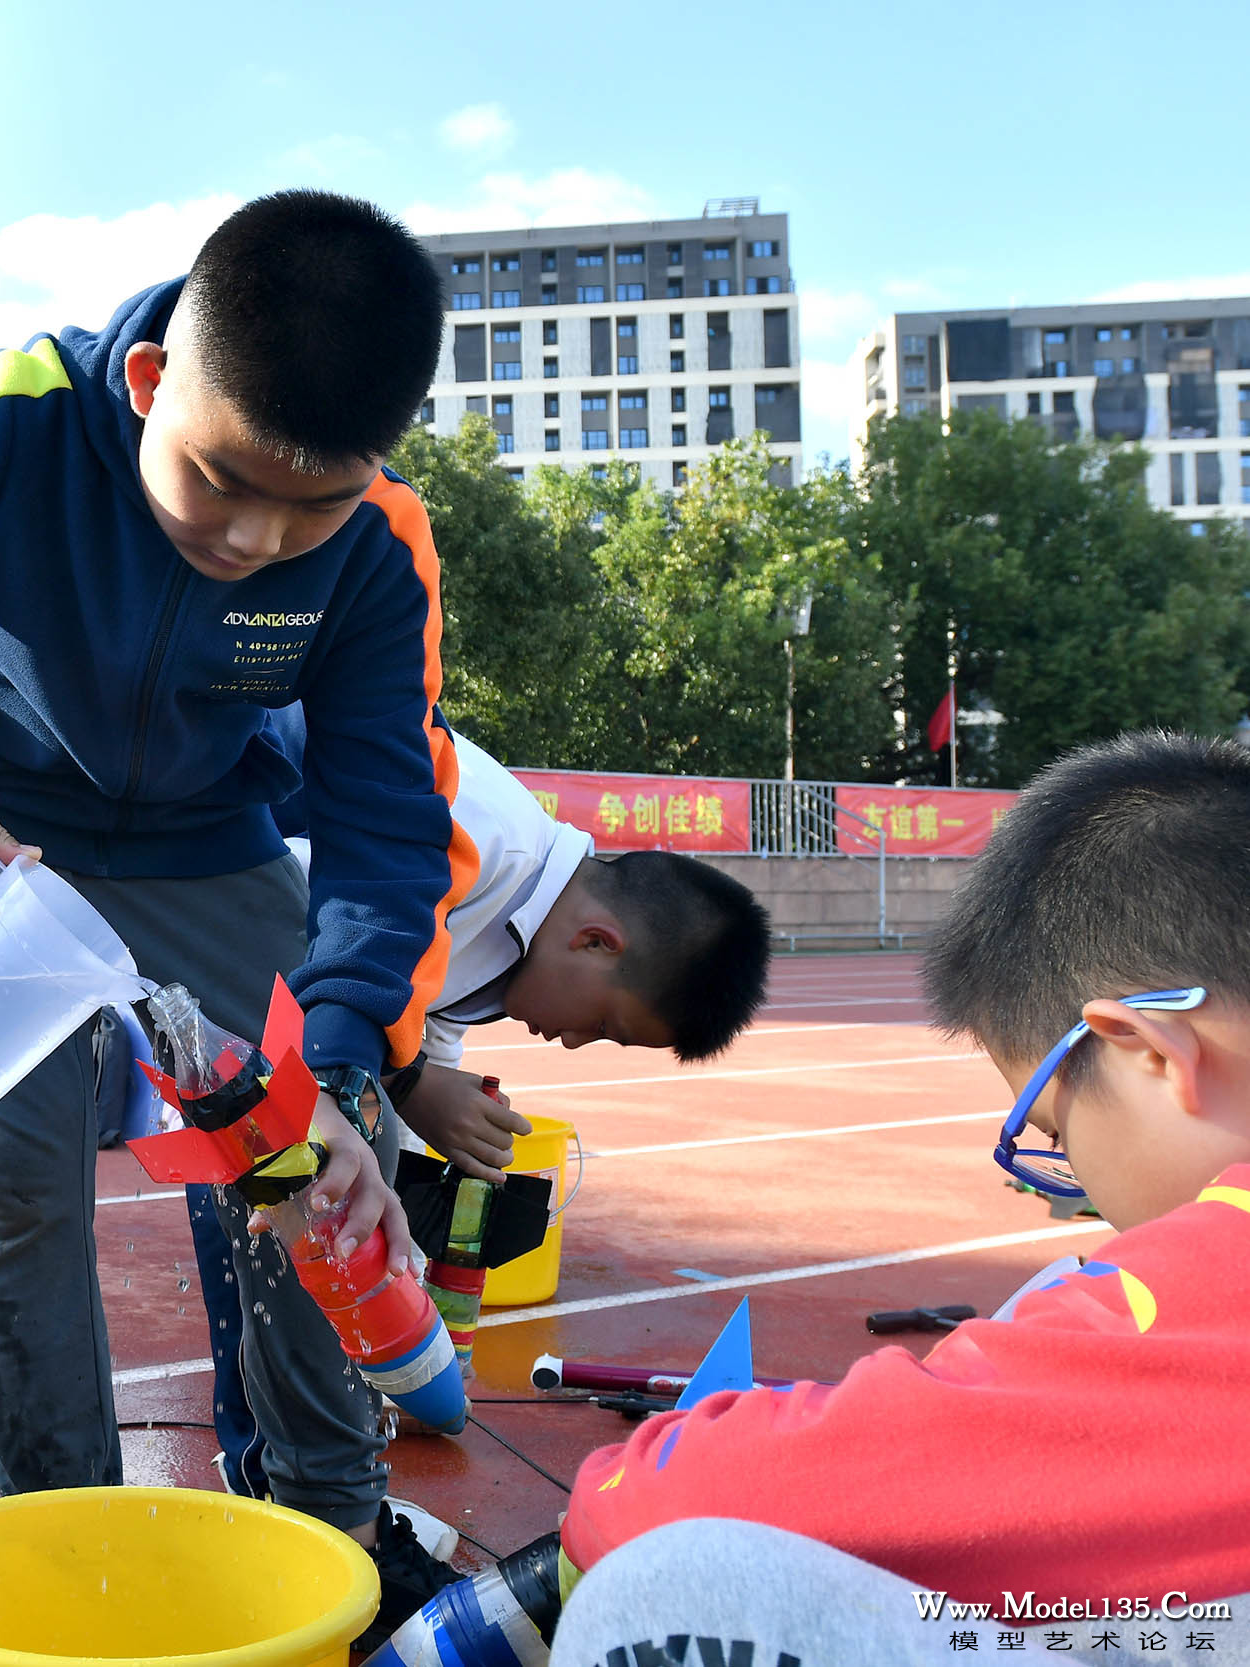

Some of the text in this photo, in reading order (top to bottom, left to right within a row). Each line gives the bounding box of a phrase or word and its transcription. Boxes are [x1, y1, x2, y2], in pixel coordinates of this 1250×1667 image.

[236, 640, 243, 649] N
[599, 791, 724, 836] 争创佳绩
